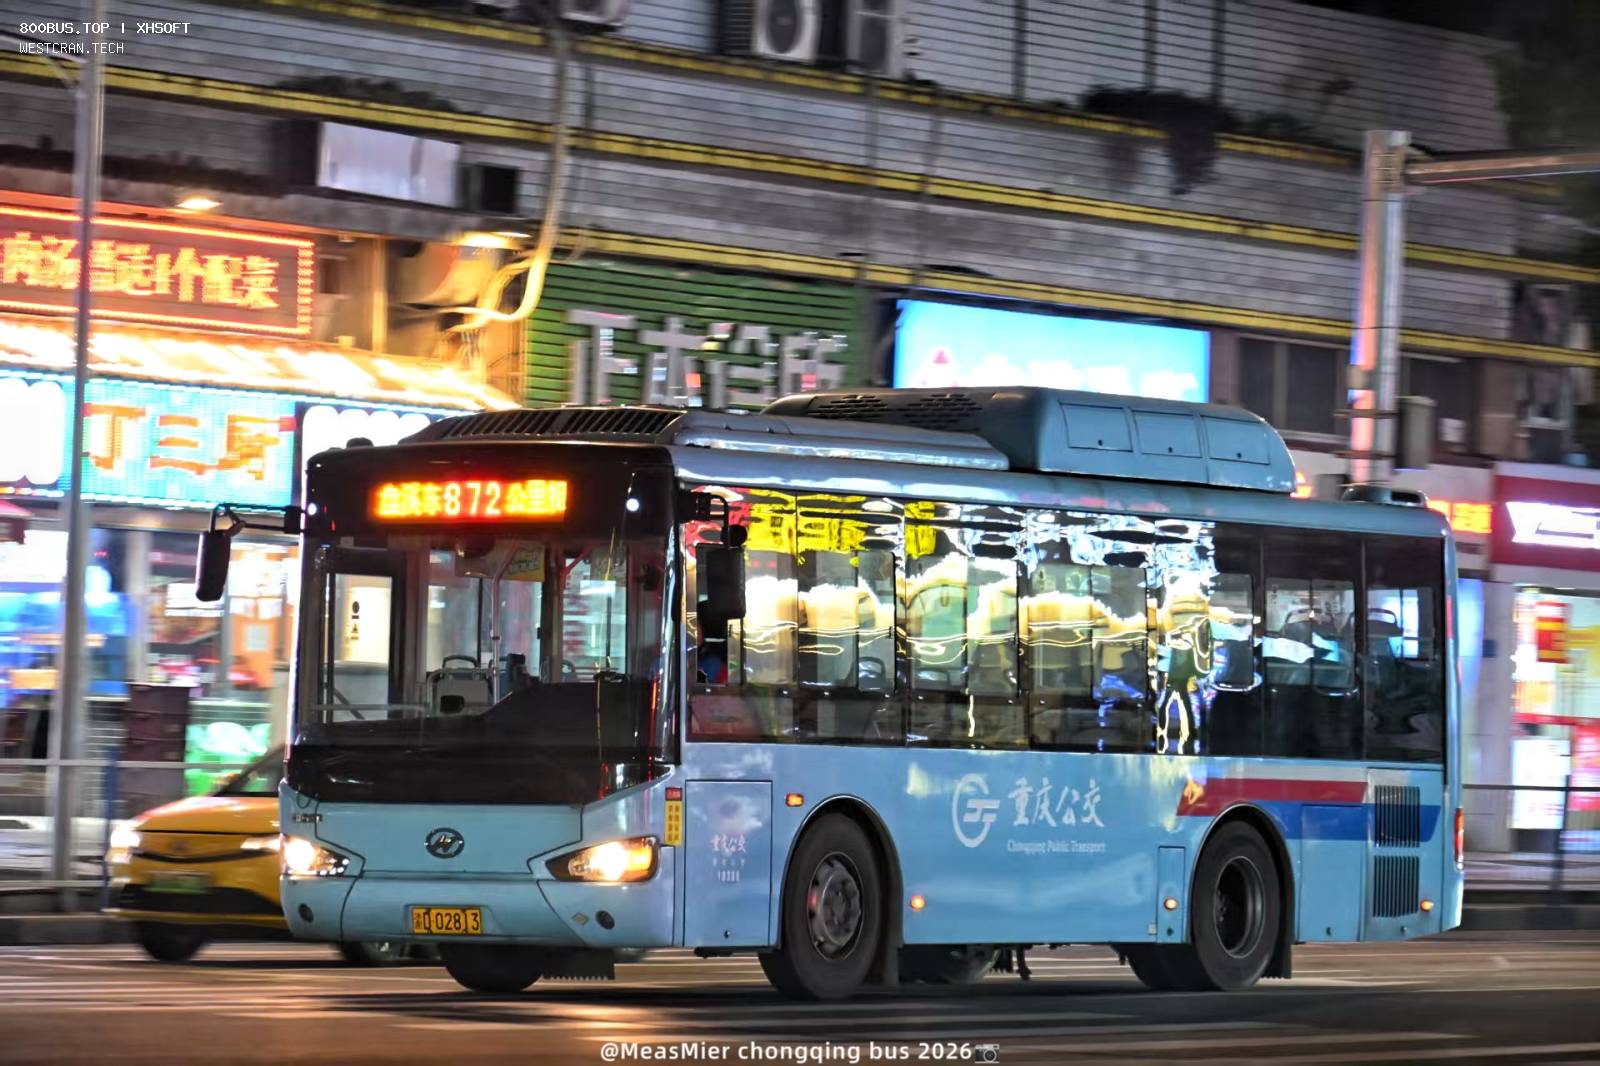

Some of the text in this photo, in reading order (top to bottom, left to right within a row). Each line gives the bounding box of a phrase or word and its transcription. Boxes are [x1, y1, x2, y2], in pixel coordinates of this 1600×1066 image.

[443, 482, 501, 516] 872
[1008, 777, 1105, 827] 重庆公交
